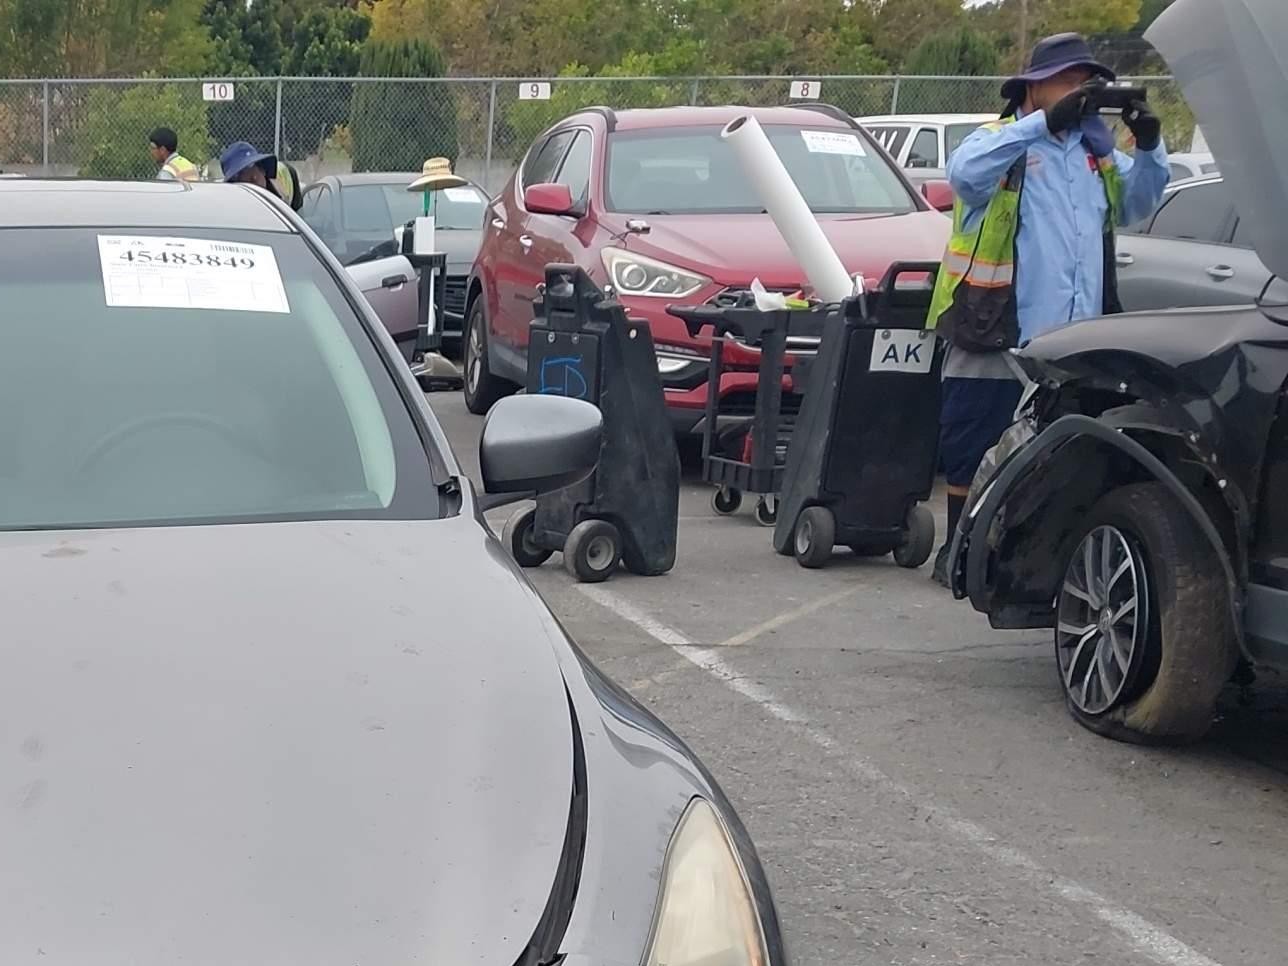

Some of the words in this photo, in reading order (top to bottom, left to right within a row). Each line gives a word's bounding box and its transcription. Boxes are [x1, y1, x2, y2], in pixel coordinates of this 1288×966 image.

[209, 84, 227, 98] 10
[530, 83, 539, 98] 9
[801, 82, 809, 97] 8
[119, 250, 255, 270] 45483849
[881, 343, 923, 363] AK
